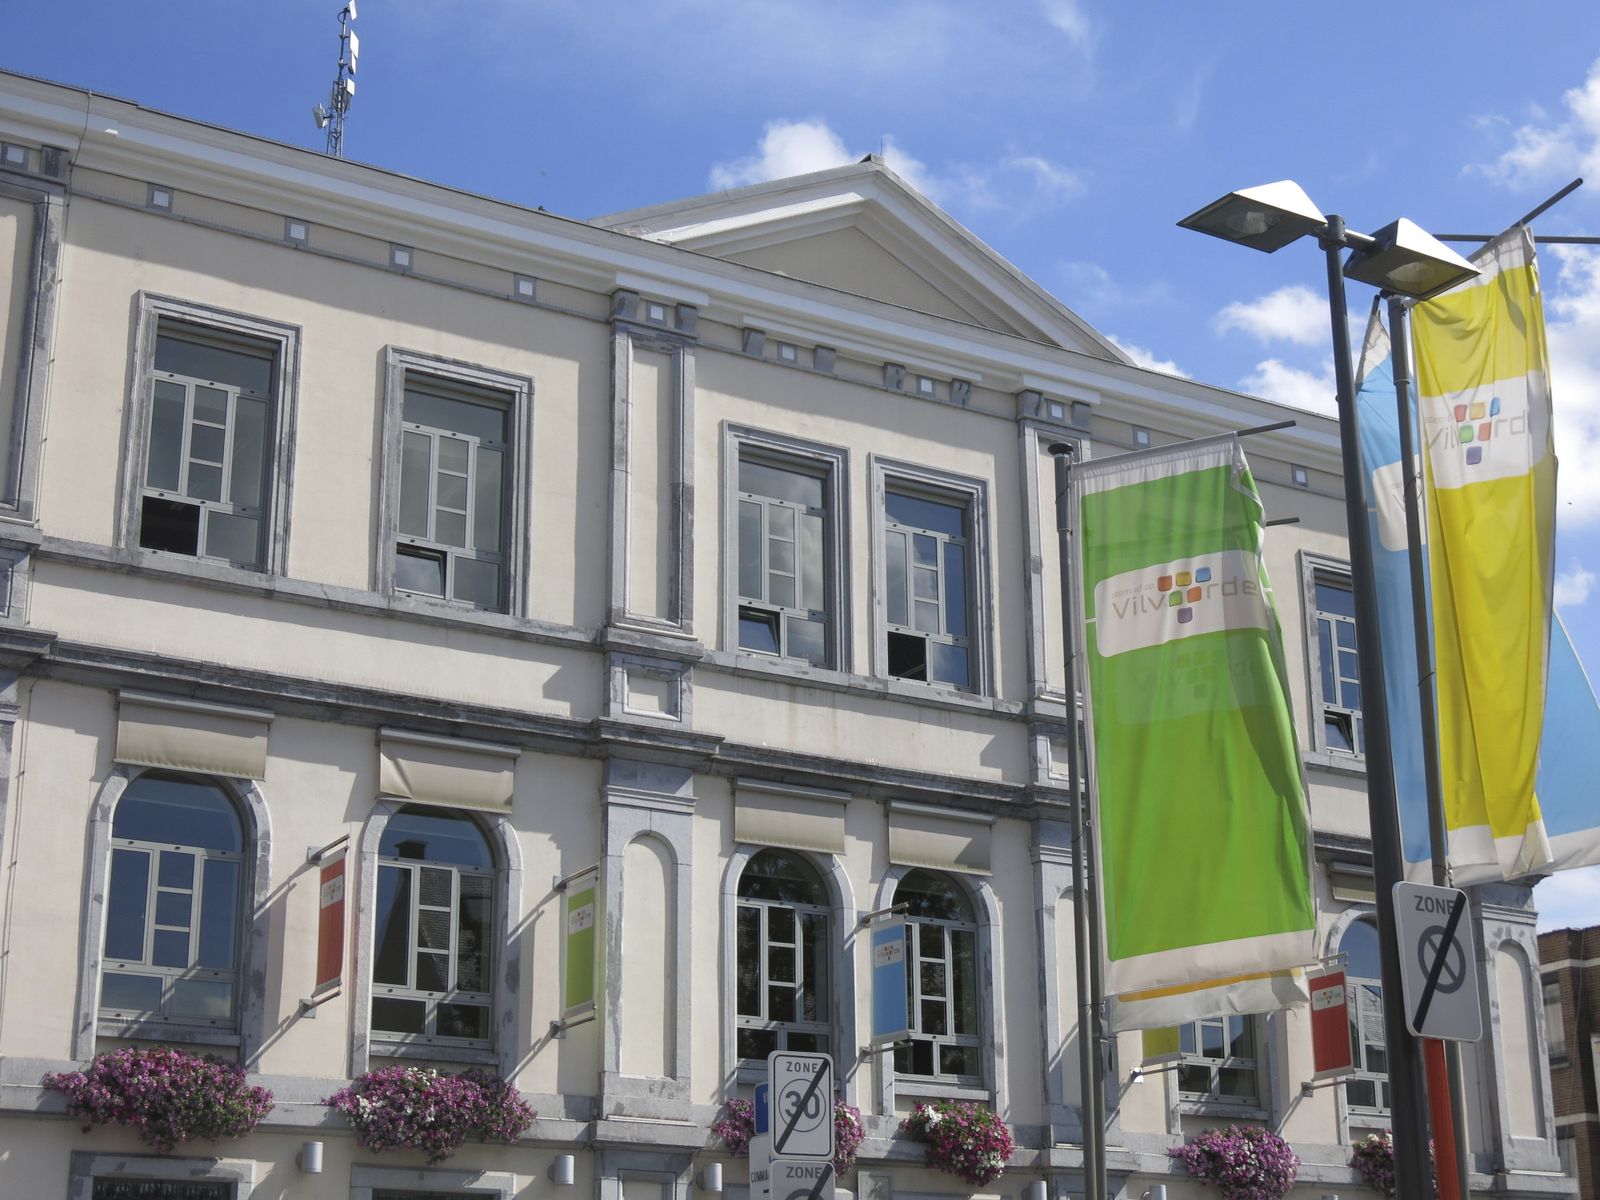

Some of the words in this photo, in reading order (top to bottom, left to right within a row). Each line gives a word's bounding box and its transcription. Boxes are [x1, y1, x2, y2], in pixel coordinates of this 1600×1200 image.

[1413, 894, 1456, 916] ZONE
[786, 1061, 819, 1074] ZONE
[785, 1090, 820, 1120] 30
[786, 1166, 823, 1180] ZONE
